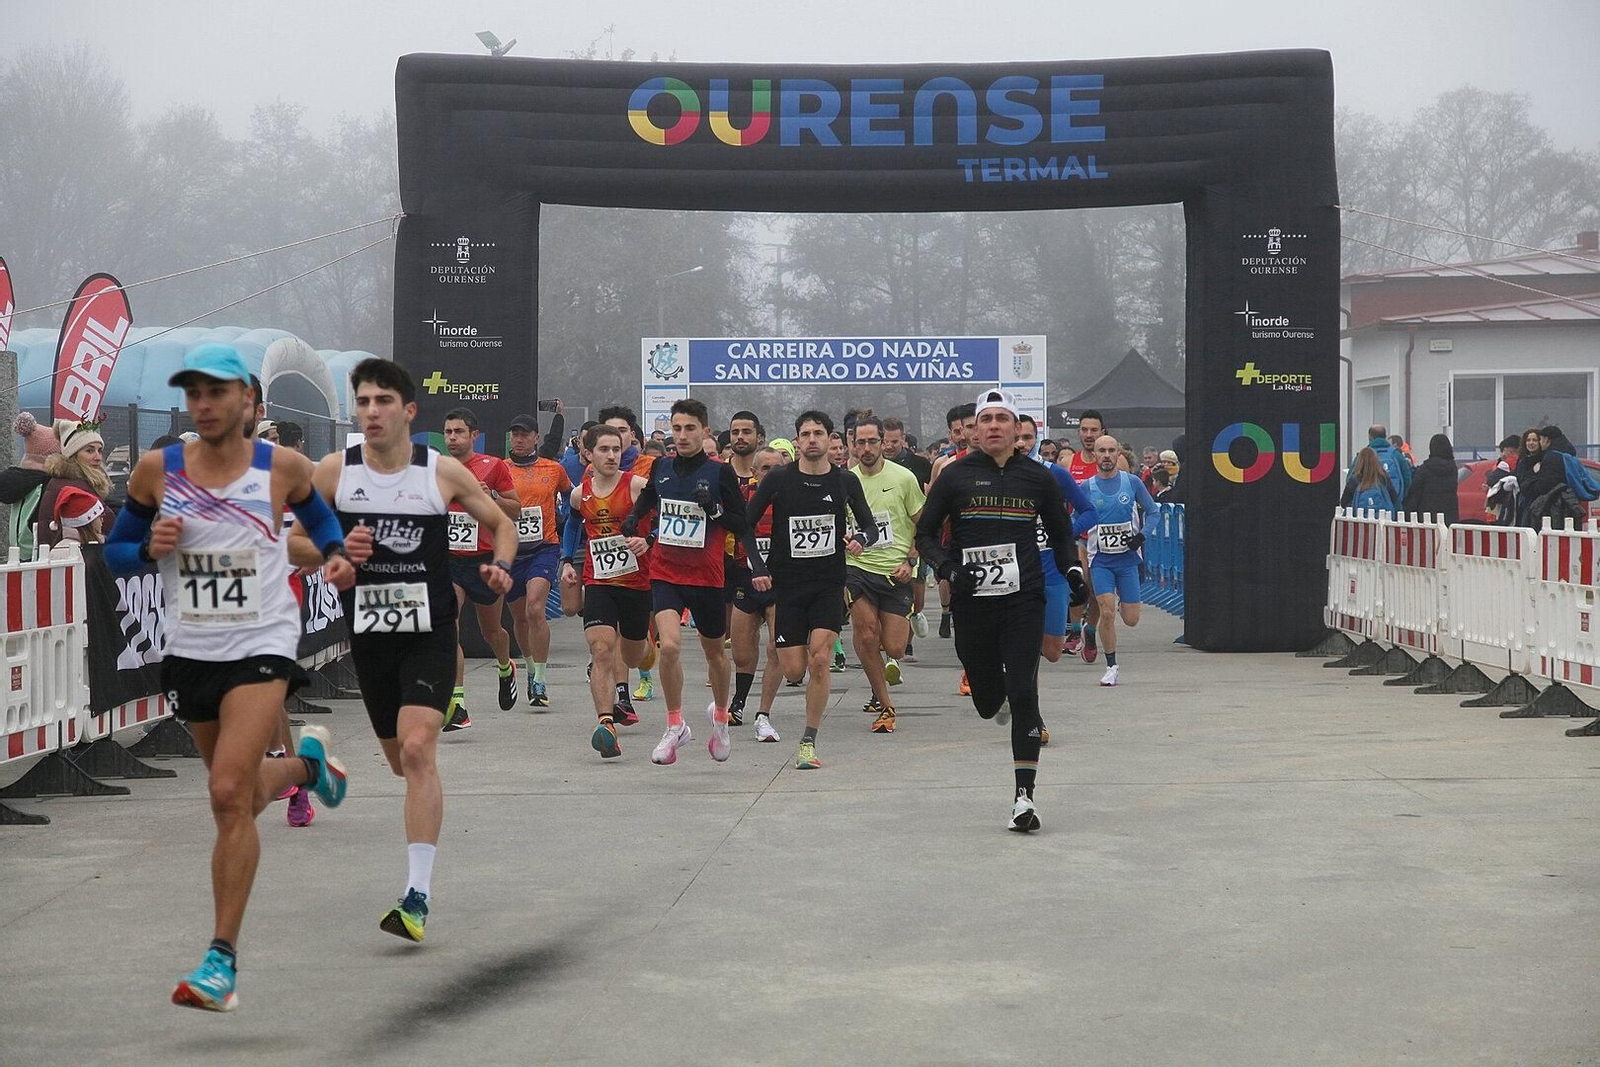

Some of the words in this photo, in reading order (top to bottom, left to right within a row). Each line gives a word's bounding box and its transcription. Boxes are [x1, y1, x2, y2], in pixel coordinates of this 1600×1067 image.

[627, 73, 1106, 147] OURENSE
[957, 154, 1108, 183] TERMAL
[430, 264, 496, 274] DEPUTACIÓN
[1241, 255, 1307, 266] DEPUTACIÓN
[1250, 266, 1298, 275] OURENSE
[439, 275, 487, 284] OURENSE
[1251, 316, 1290, 327] inorde
[439, 325, 478, 336] inorde
[1252, 330, 1281, 339] turismo
[1282, 330, 1315, 339] Ourense
[439, 339, 468, 348] turismo
[470, 339, 503, 348] Ourense
[727, 342, 835, 359] CARREIRA
[842, 342, 875, 359] DO
[882, 341, 959, 358] NADAL
[58, 316, 130, 422] BRIL
[714, 363, 760, 380] SAN
[767, 362, 850, 380] CIBRAO
[856, 362, 899, 379] DAS
[905, 358, 974, 379] VIÑAS
[1272, 383, 1283, 391] La
[1211, 422, 1336, 484] OU
[969, 496, 1035, 508] ATHLETICS
[518, 520, 541, 536] 53
[662, 516, 700, 538] 707
[793, 530, 832, 549] 297
[1101, 533, 1130, 548] 128
[595, 550, 629, 571] 199
[974, 565, 1006, 586] 92
[184, 577, 248, 609] 114
[362, 608, 420, 633] 291
